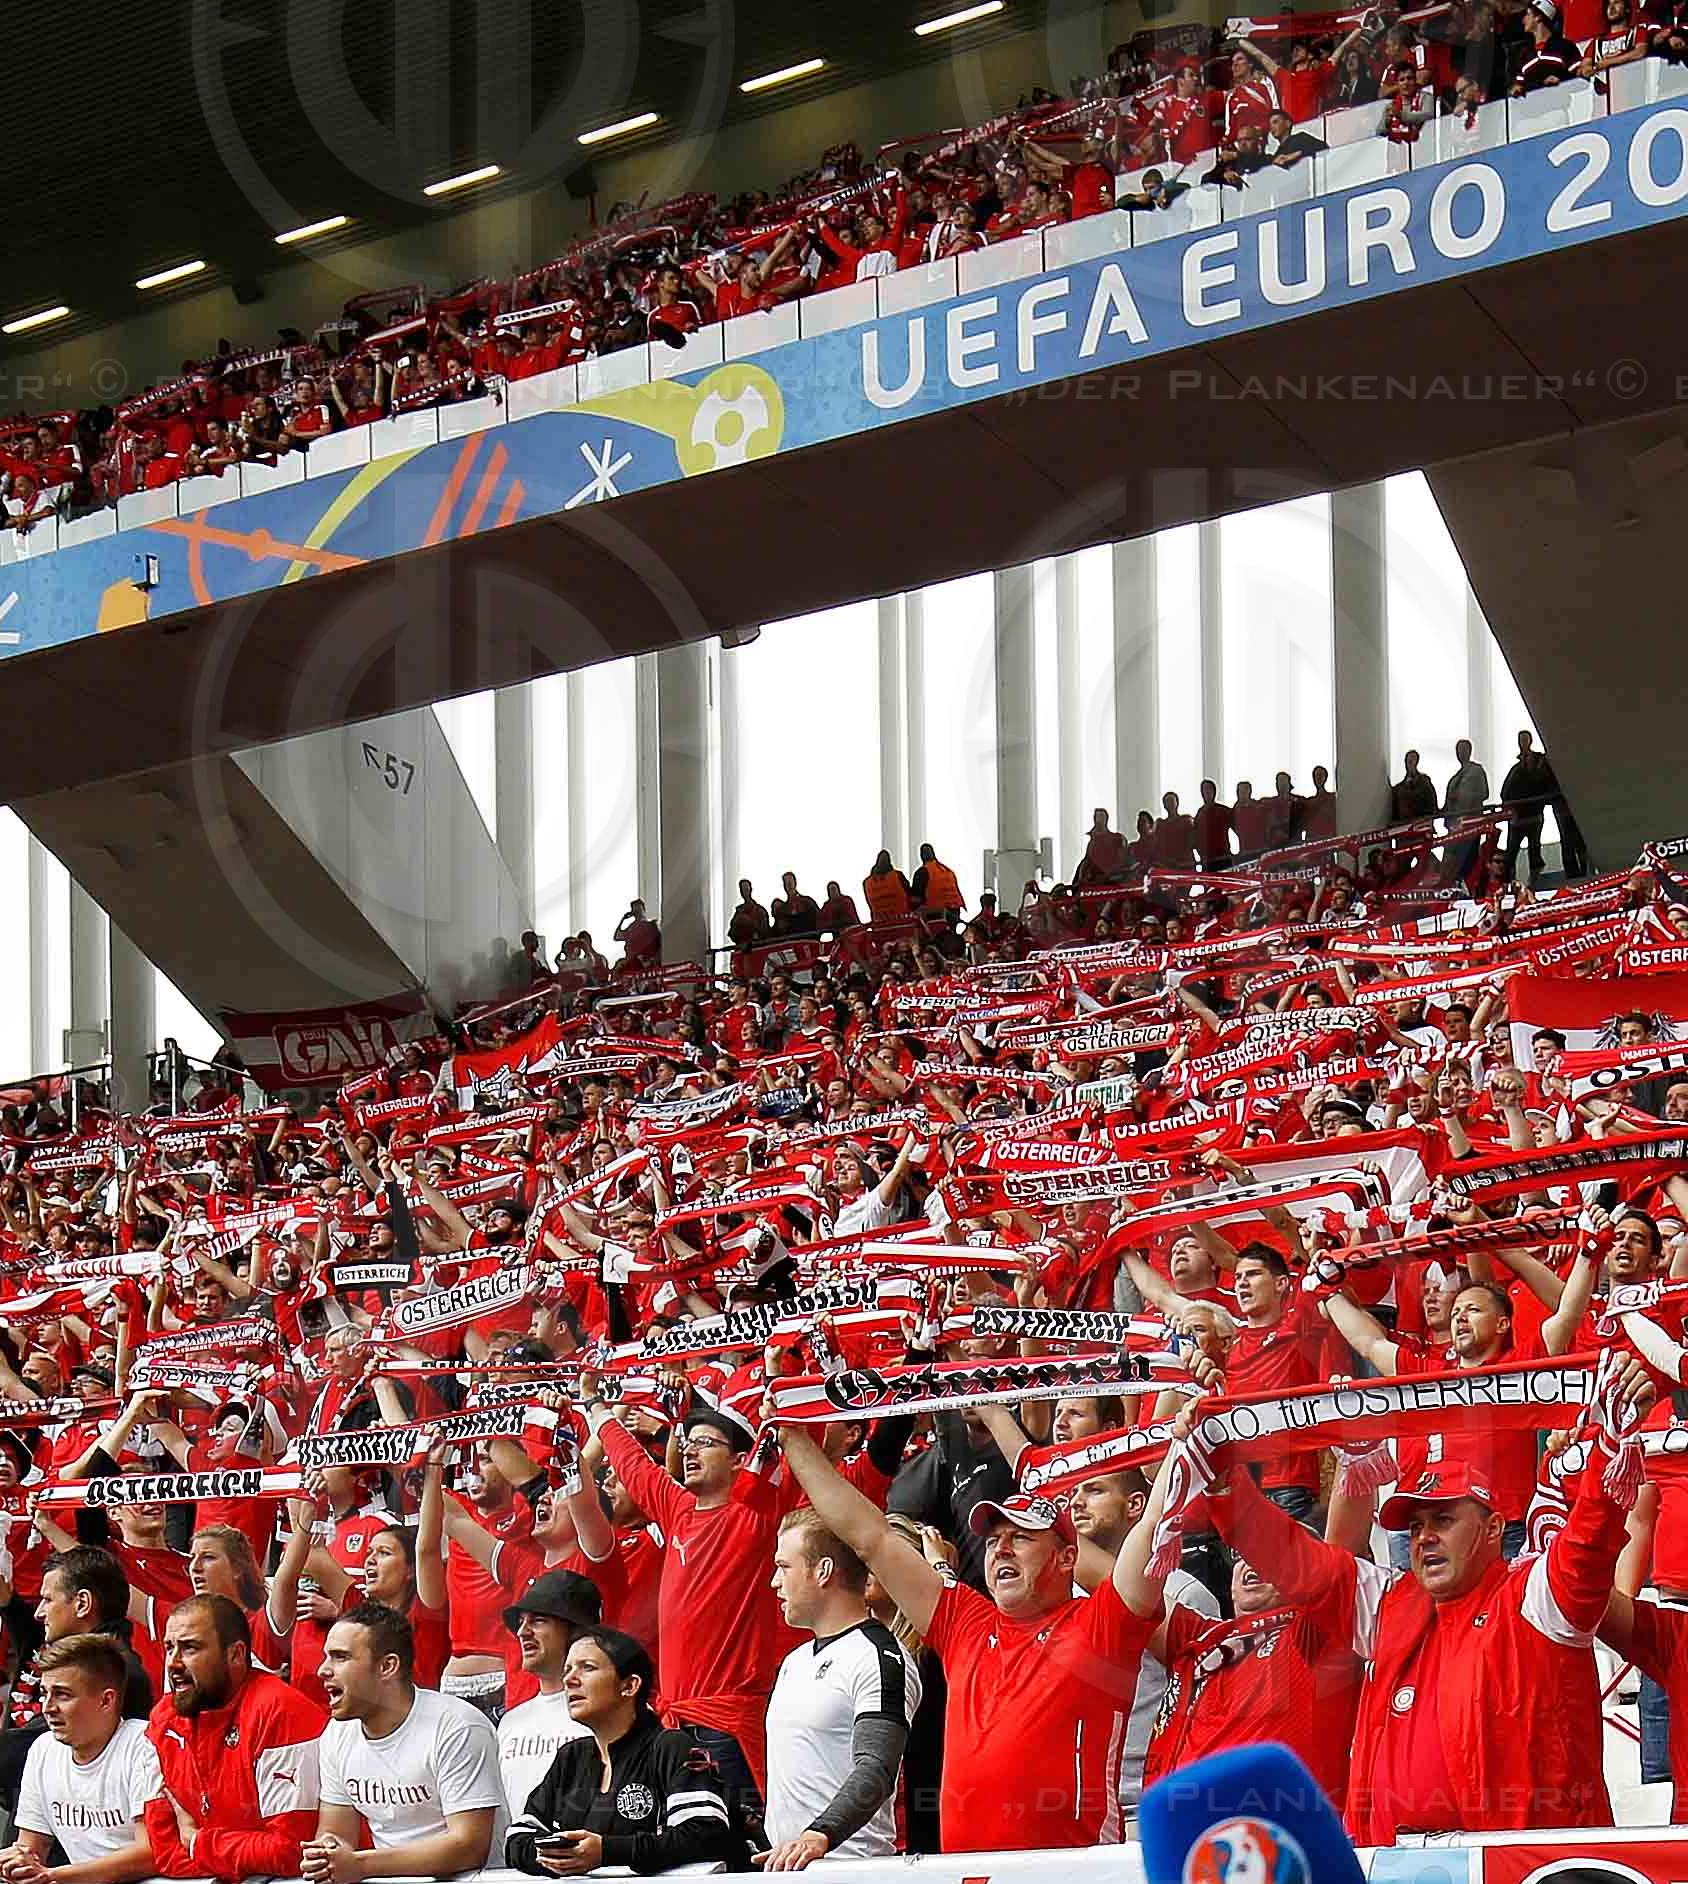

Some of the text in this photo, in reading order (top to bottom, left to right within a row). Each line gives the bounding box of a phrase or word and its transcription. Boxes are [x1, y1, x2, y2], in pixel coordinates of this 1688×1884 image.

[860, 261, 1150, 412] UEFA
[1180, 162, 1507, 328] EURO
[381, 750, 417, 797] 57
[1067, 1024, 1169, 1053] ÖSTERREICH
[365, 1094, 428, 1119] ÖSTERREICH
[1077, 1081, 1125, 1104] AUSTRIA
[996, 1141, 1104, 1166] ÖSTERREICH
[1005, 1161, 1169, 1197] ÖSTERREICH
[335, 1266, 409, 1282] ÖSTERREICH
[400, 1269, 523, 1327] ÖSTERREICH
[824, 1350, 1153, 1412] Österreich
[1334, 1367, 1588, 1418] ÖSTERREICH
[85, 1470, 265, 1508] ÖSTERREICH
[345, 1777, 433, 1821] Altheim
[50, 1801, 127, 1846] Altheim
